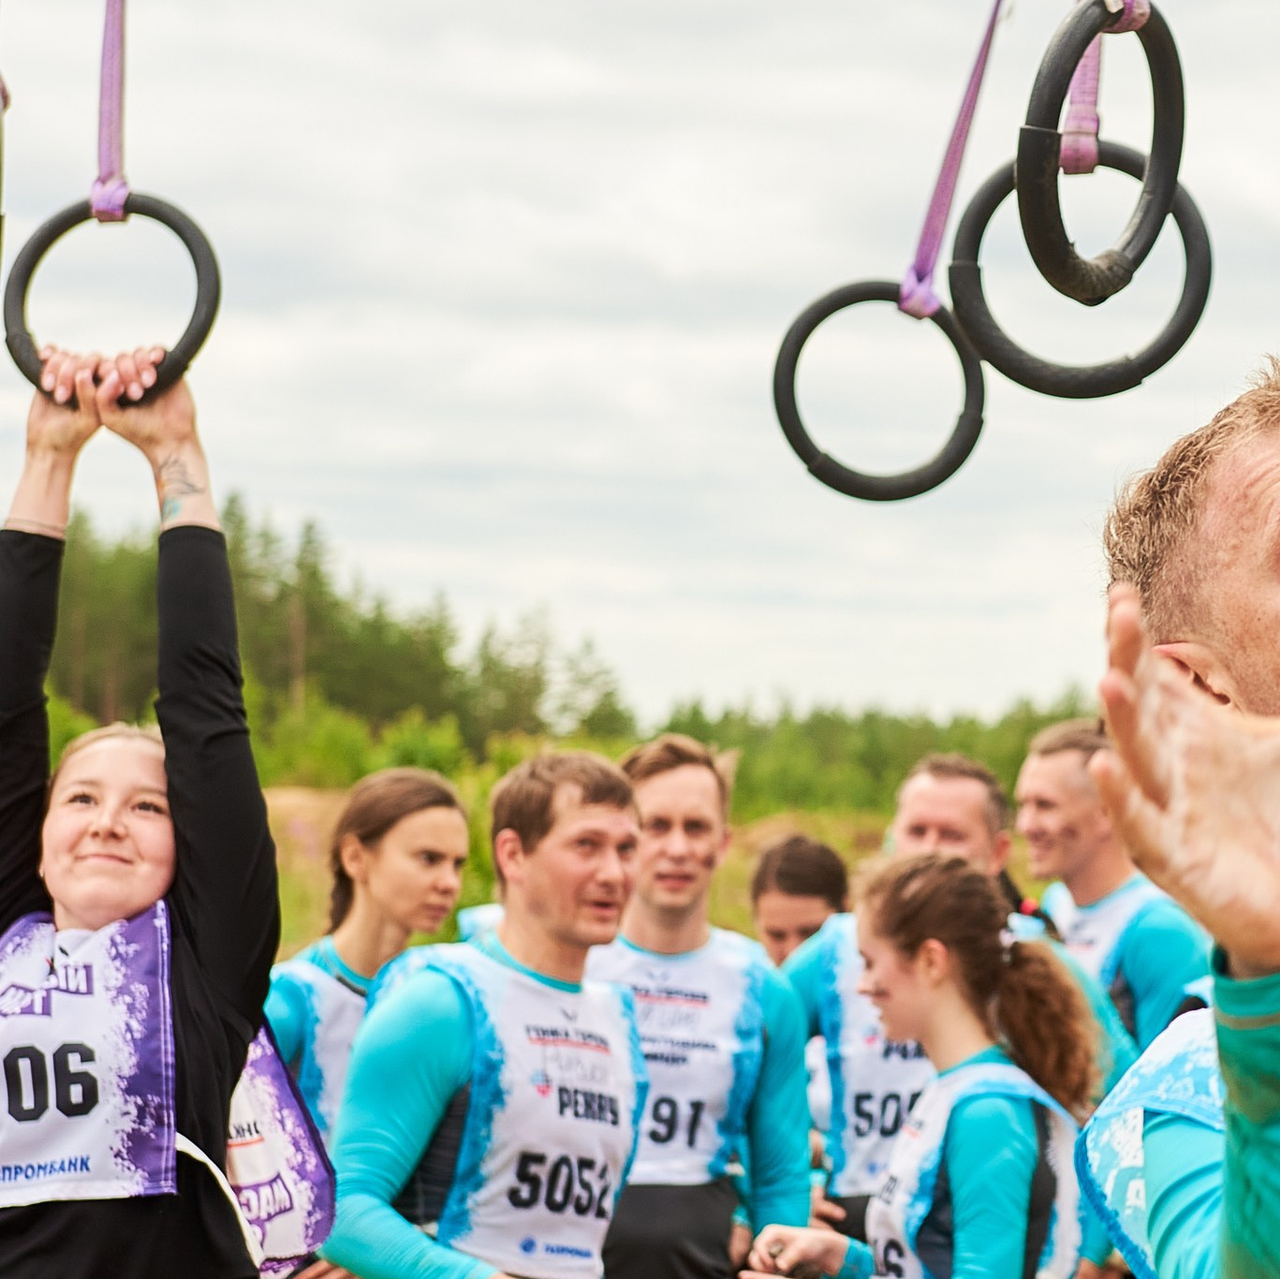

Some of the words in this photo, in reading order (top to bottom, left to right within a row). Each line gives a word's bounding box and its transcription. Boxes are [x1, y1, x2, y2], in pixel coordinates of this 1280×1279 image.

[3, 1043, 99, 1122] 06
[649, 1096, 705, 1149] 91
[507, 1151, 609, 1220] 5052
